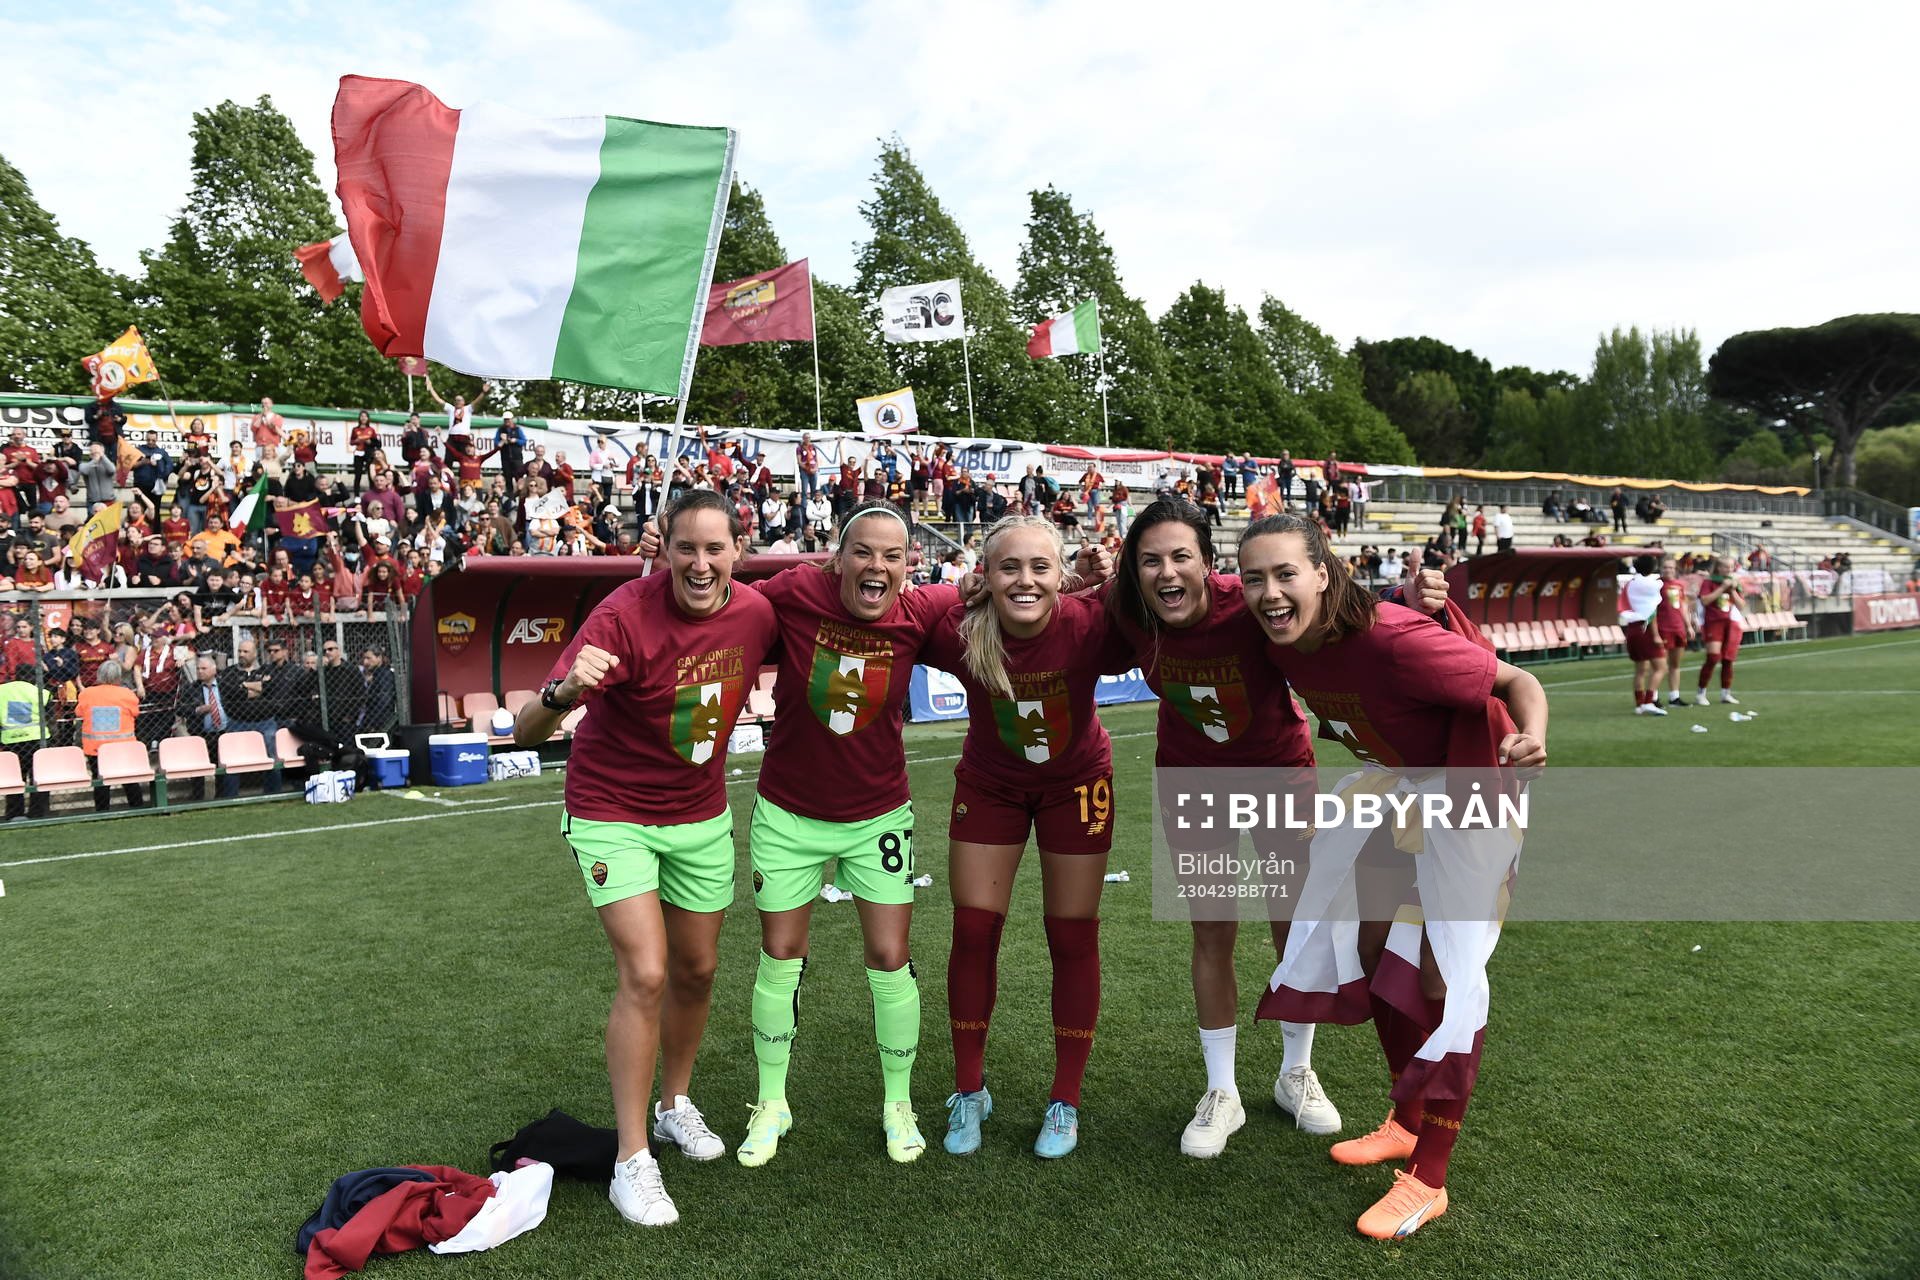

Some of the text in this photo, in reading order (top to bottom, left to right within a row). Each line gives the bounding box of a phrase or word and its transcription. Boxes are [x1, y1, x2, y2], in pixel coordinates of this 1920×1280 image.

[442, 635, 469, 644] ROMA
[507, 618, 565, 644] ASR
[944, 696, 961, 706] TIM
[1074, 779, 1110, 823] 19
